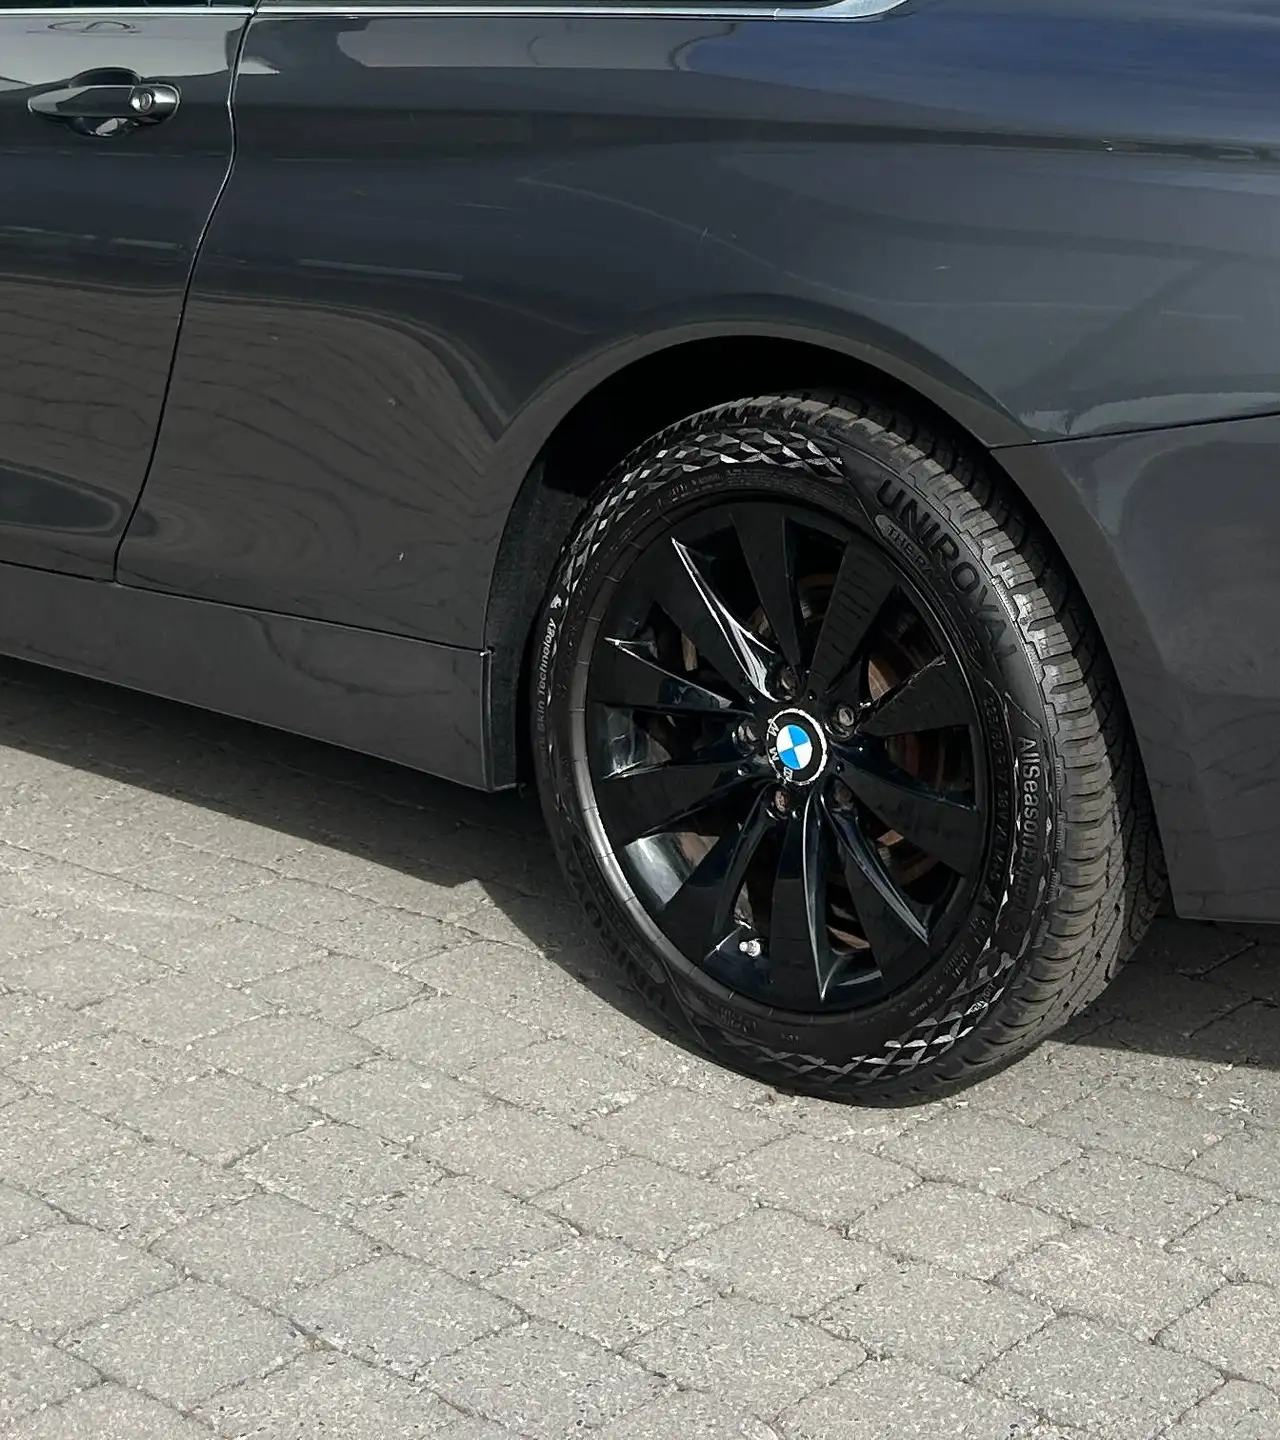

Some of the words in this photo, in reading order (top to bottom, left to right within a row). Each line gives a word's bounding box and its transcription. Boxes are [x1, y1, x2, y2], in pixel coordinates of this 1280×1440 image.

[875, 477, 1019, 672] UNIROYAL
[886, 525, 915, 556] THE
[536, 617, 557, 697] Technology
